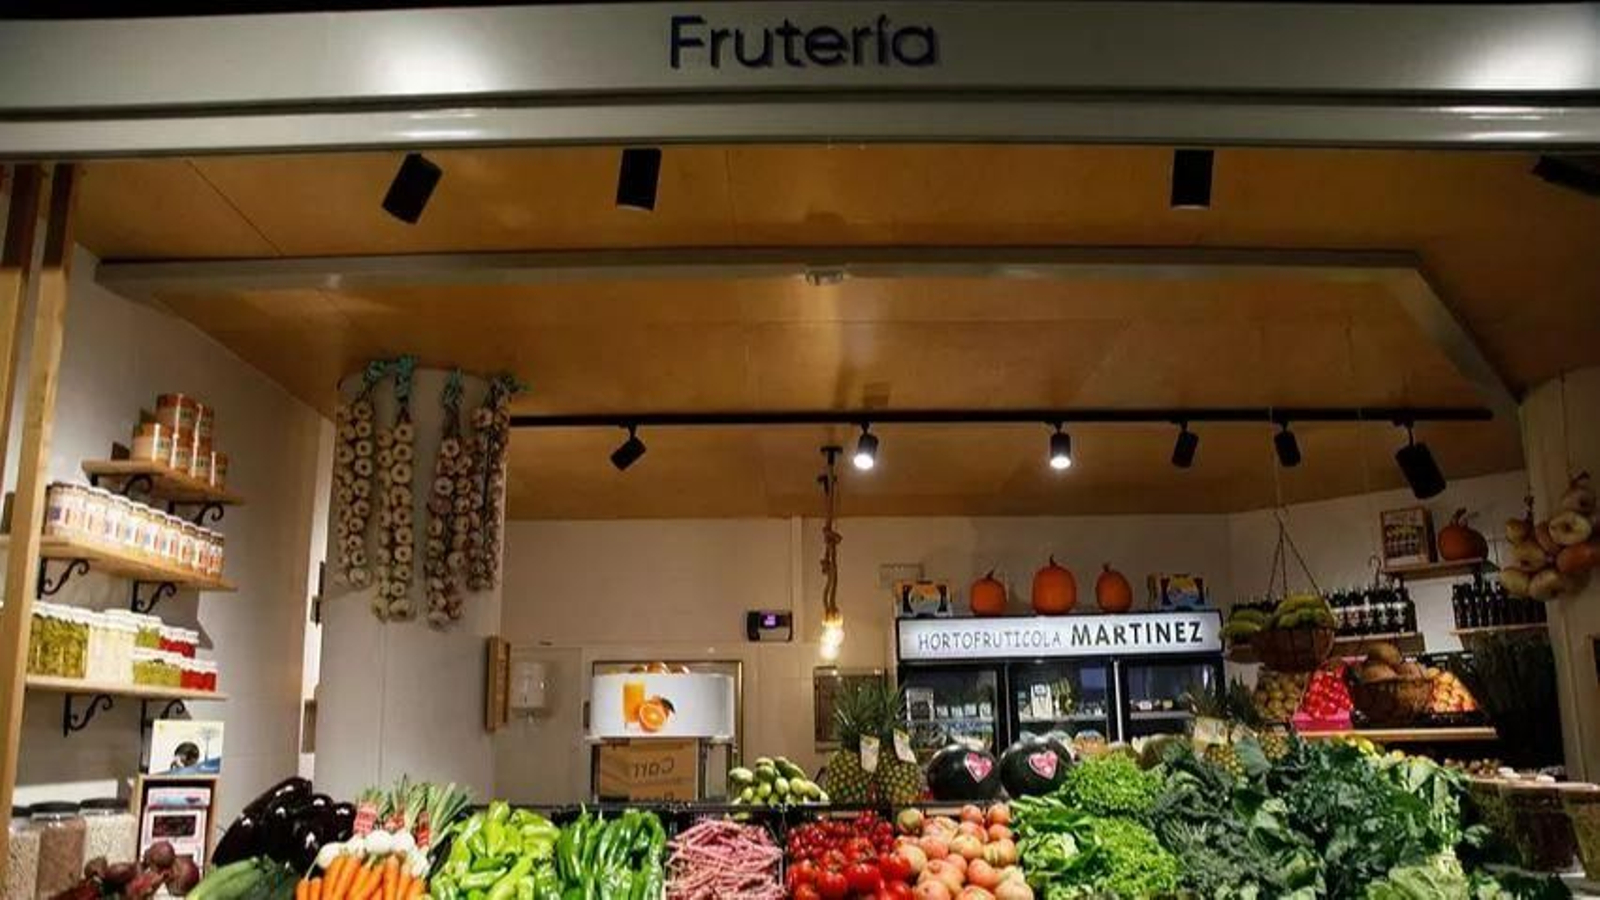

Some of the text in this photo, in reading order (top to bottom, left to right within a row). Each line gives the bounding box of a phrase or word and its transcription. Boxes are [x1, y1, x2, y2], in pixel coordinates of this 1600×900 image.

[670, 13, 937, 69] Frutería
[918, 621, 1203, 650] HORTOFRUTICOLA MARTINEZ
